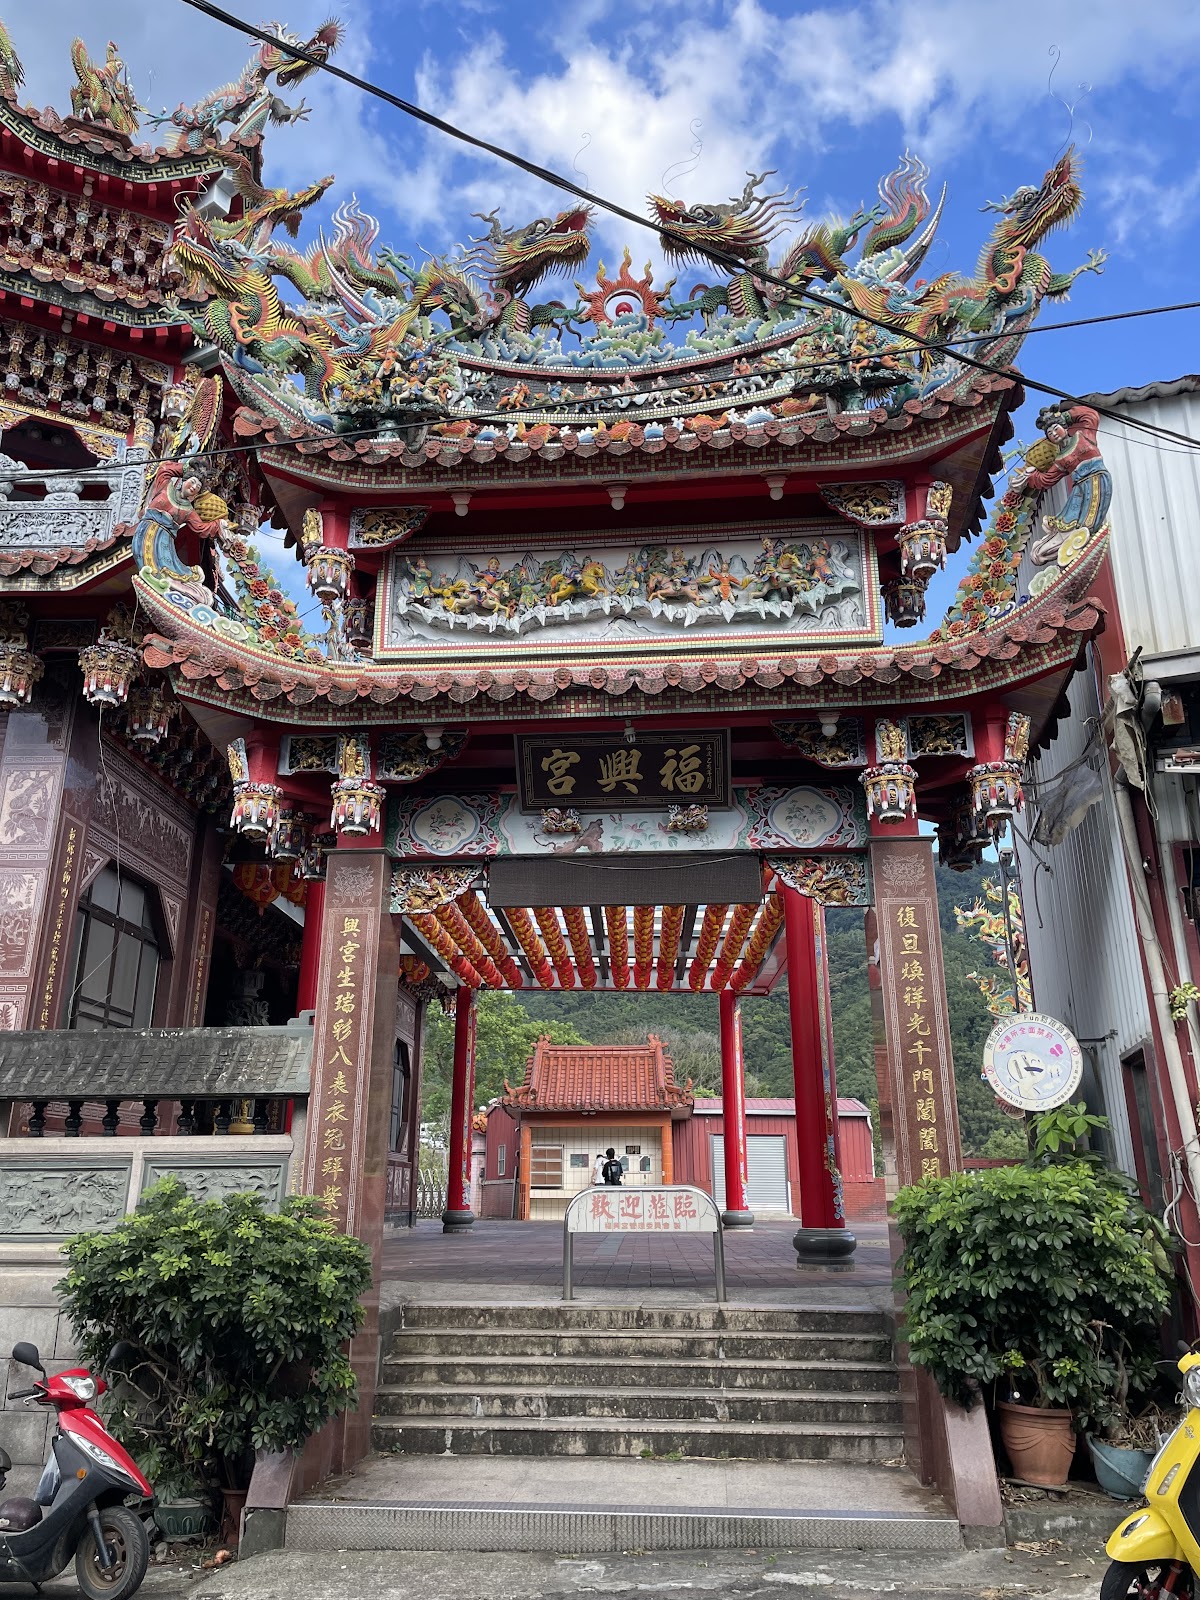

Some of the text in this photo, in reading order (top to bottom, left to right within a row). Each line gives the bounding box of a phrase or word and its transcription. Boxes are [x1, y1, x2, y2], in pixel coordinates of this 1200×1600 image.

[541, 744, 705, 796] 福興宮
[589, 1193, 697, 1220] 歡迎蒞臨
